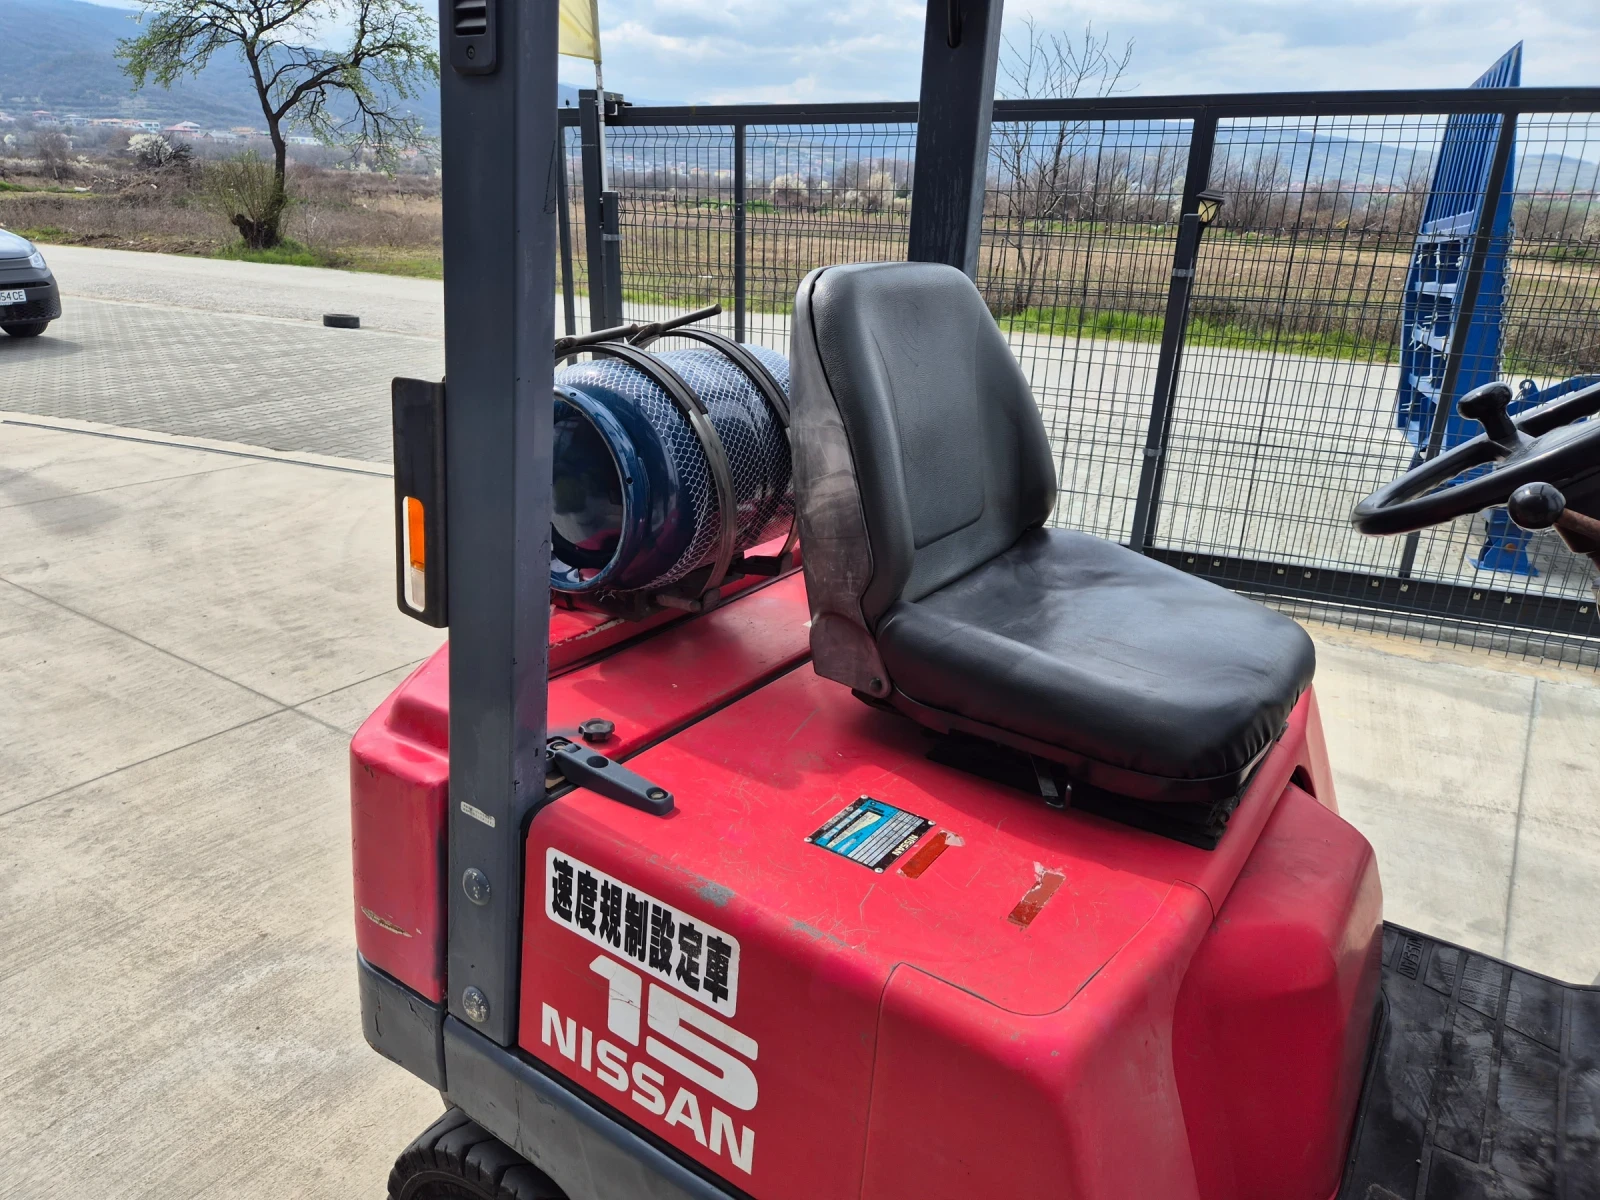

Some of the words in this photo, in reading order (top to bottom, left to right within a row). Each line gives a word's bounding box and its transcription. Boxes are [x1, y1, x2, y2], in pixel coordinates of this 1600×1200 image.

[0, 291, 12, 301] 54
[891, 834, 919, 856] NISSAN
[552, 856, 732, 1004] 速度規制設定車
[1400, 938, 1423, 976] NISSAN
[589, 954, 759, 1111] 15
[541, 1001, 756, 1176] NISSAN
